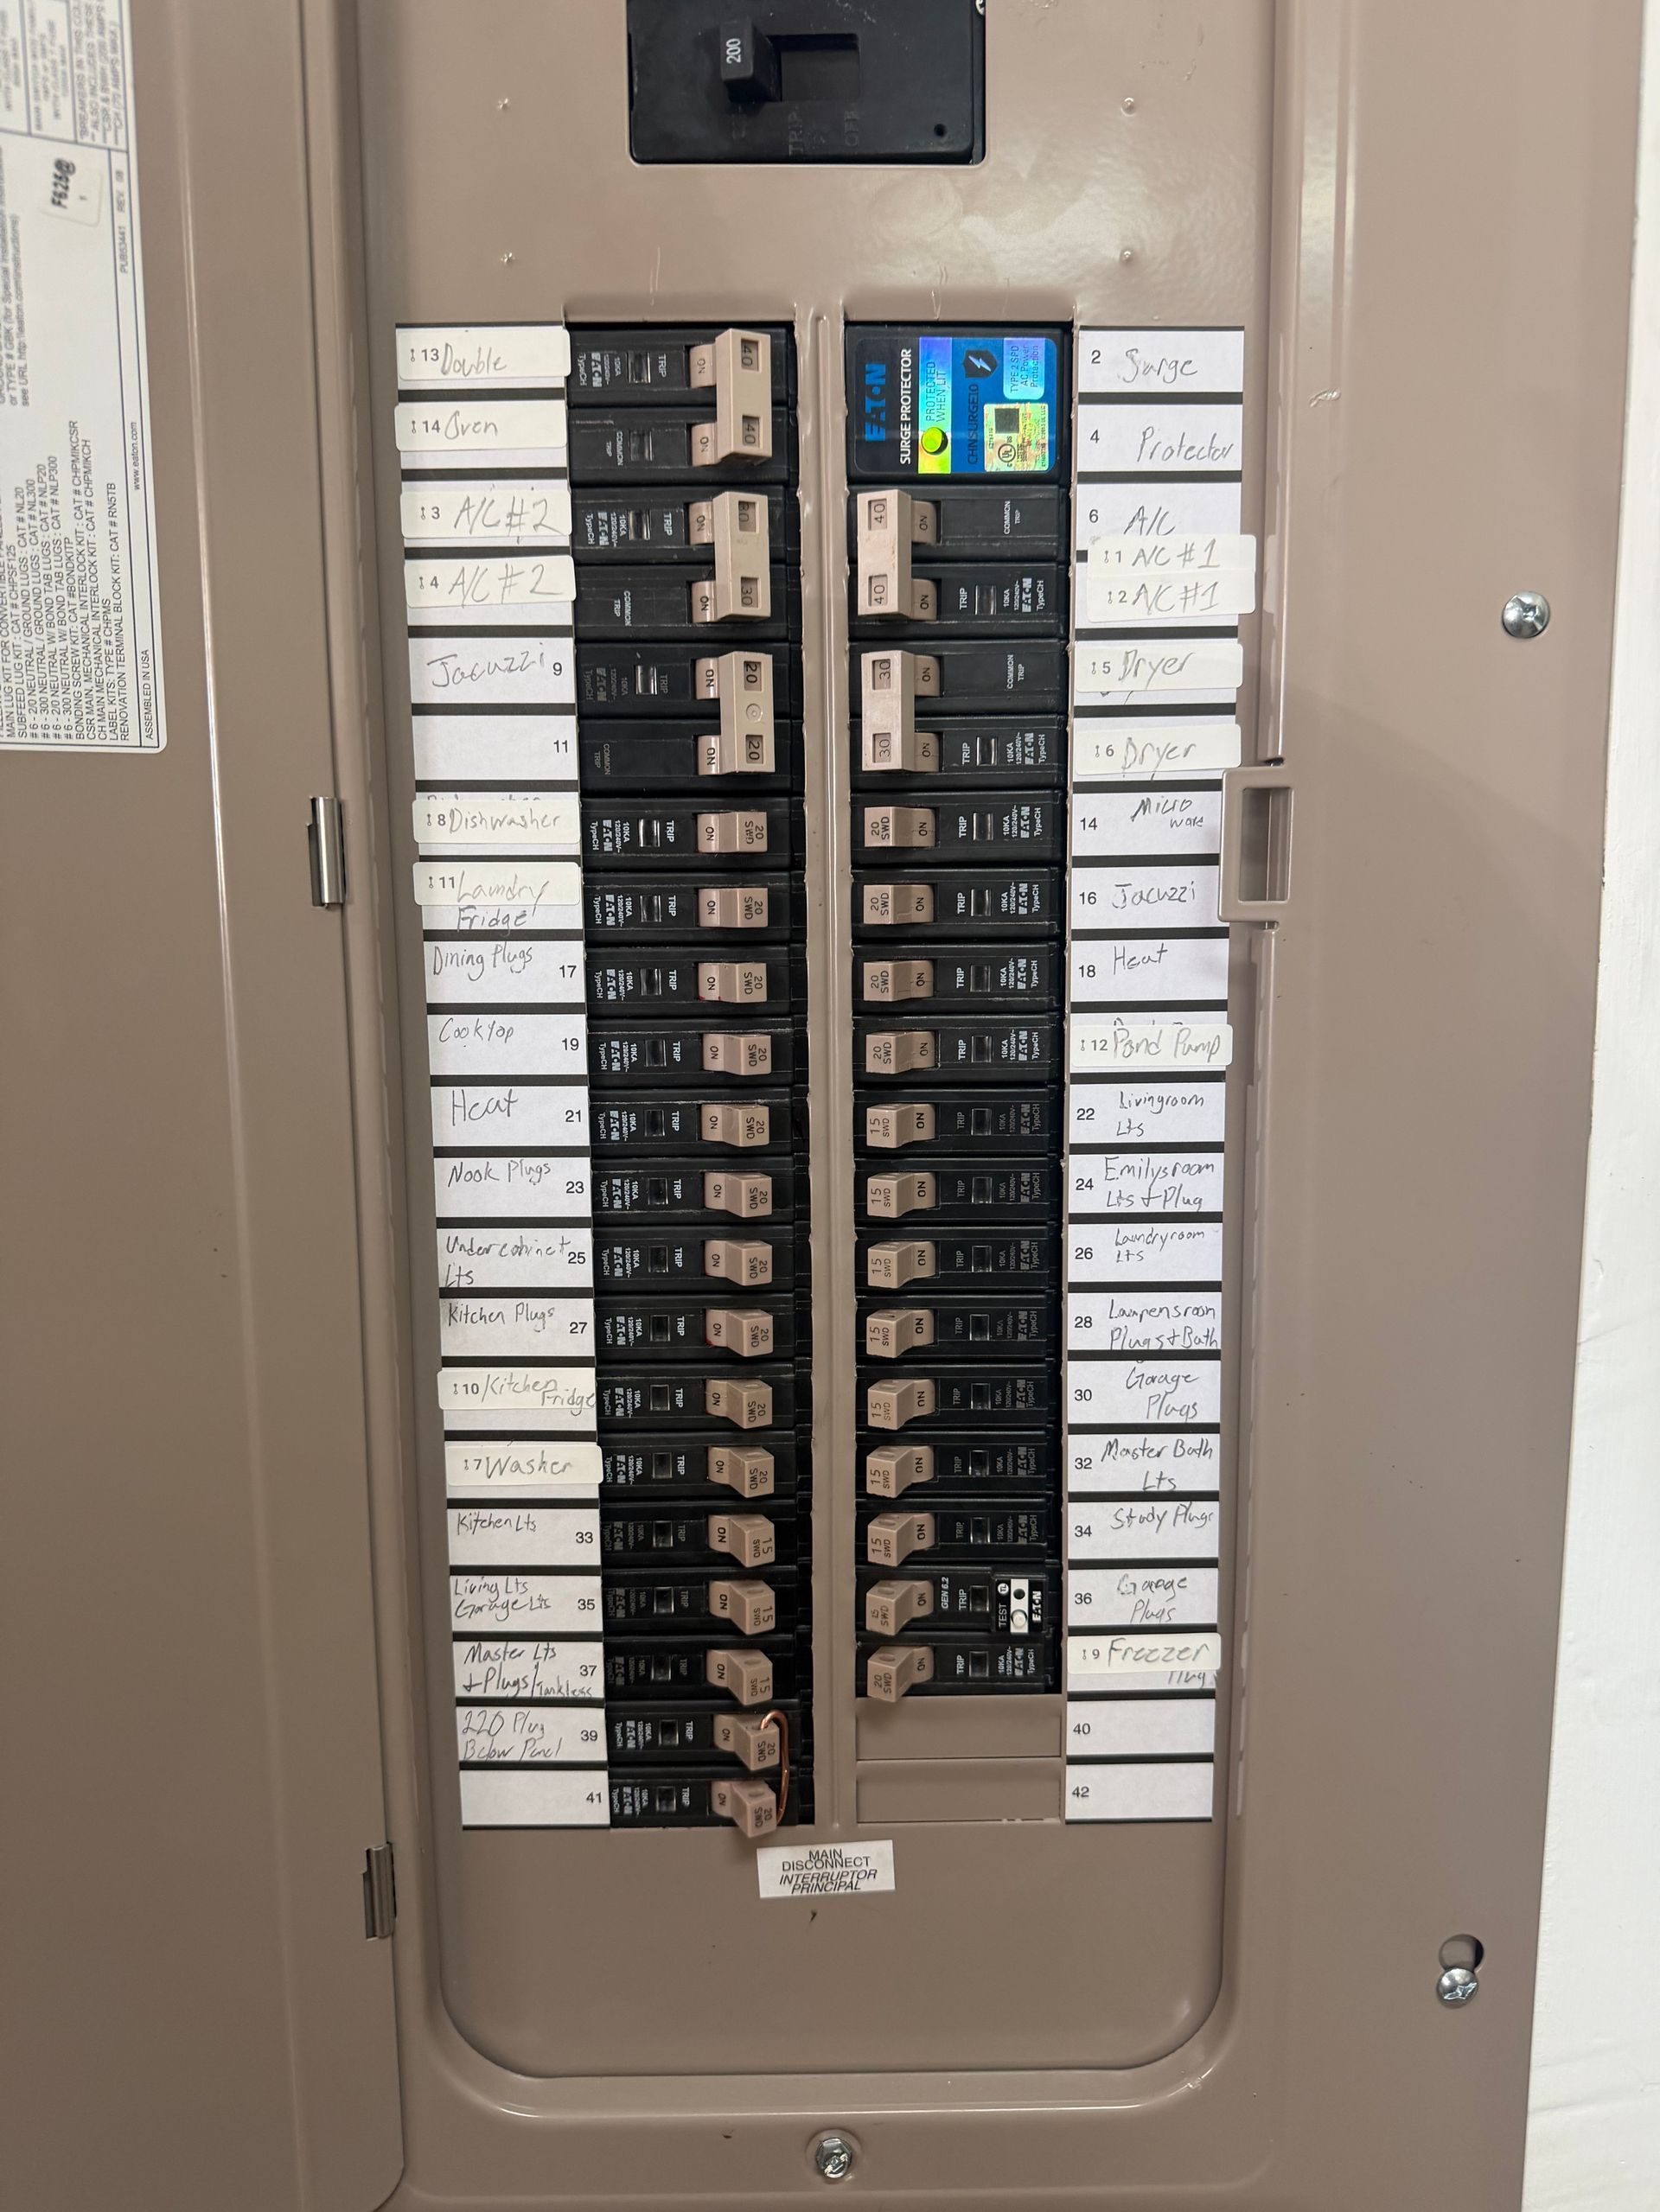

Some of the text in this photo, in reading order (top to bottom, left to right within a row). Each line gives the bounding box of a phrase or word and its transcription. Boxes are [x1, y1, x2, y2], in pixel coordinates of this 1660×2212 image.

[725, 38, 741, 64] 200
[421, 349, 439, 362] 13
[441, 342, 508, 376] Double
[741, 345, 753, 367] 40
[1012, 345, 1020, 363] SPD
[1091, 351, 1101, 364] 2
[1021, 345, 1030, 387] AC Power
[1031, 346, 1039, 388] Protection
[1122, 348, 1198, 384] Surge
[926, 361, 936, 422] PROTECTED
[1011, 373, 1019, 394] TYPE
[900, 348, 912, 465] SURGE PROTECTOR
[936, 372, 948, 422] WHEN LIT
[422, 421, 440, 433] 14
[444, 410, 498, 441] Oven
[744, 423, 757, 444] 40
[1090, 430, 1100, 443] 4
[1136, 426, 1235, 462] Protector
[130, 421, 140, 492] www.eaton.com
[432, 507, 441, 520] 3
[454, 494, 501, 535] A/C
[874, 502, 885, 524] 40
[1089, 510, 1099, 523] 6
[1116, 551, 1122, 563] 1
[1132, 538, 1221, 570] A/C #1
[430, 577, 439, 589] 4
[449, 564, 565, 608] A/C #2
[699, 595, 709, 611] ON
[1118, 590, 1127, 603] 2
[1132, 580, 1220, 612] A/C #1
[112, 577, 130, 742] RENOVATION TERMINAL BLOCK
[426, 644, 545, 688] Jacuzzi
[553, 662, 563, 676] 9
[1102, 661, 1111, 674] 5
[1119, 650, 1197, 690] Dryer
[745, 663, 757, 685] 20
[71, 653, 85, 741] BONDING SCREW
[141, 649, 154, 741] ASSEMBLED IN USA
[16, 687, 28, 738] SUBFEED
[553, 741, 568, 754] 11
[1105, 745, 1114, 757] 6
[1122, 738, 1197, 778] Dryer
[437, 814, 446, 826] 8
[449, 808, 561, 834] Dishwasher
[1080, 819, 1098, 831] 14
[667, 820, 675, 843] TRIP
[439, 877, 456, 889] 11
[456, 870, 550, 916] Laundry
[1079, 892, 1097, 905] 16
[1112, 882, 1196, 909] Jacuzzi
[457, 905, 528, 936] Fridge
[432, 944, 533, 981] Dining Plugs
[1113, 944, 1169, 976] Heat
[559, 966, 577, 978] 17
[625, 971, 634, 991] 10KA
[668, 969, 678, 991] TRIP
[1078, 966, 1095, 978] 18
[561, 1038, 579, 1051] 19
[1091, 1039, 1108, 1052] 12
[1113, 1029, 1222, 1064] Pond Pump
[450, 1088, 519, 1127] Heat
[1119, 1091, 1205, 1114] Livingroom
[565, 1111, 582, 1123] 21
[916, 1112, 925, 1130] ON
[1076, 1108, 1095, 1121] 22
[870, 1117, 880, 1137] 15
[1116, 1121, 1144, 1138] Lts
[448, 1160, 552, 1187] Nook Plugs
[565, 1182, 584, 1195] 23
[1076, 1178, 1094, 1191] 24
[1107, 1189, 1134, 1208] Lts
[1114, 1227, 1205, 1252] Laundryroom
[567, 1252, 586, 1265] 25
[1075, 1247, 1093, 1260] 26
[1115, 1249, 1144, 1263] Lts
[444, 1264, 475, 1287] Lts
[448, 1302, 555, 1333] Kitchen Plugs
[1074, 1316, 1093, 1329] 28
[569, 1322, 588, 1335] 27
[463, 1383, 479, 1395] 10
[482, 1372, 559, 1395] Kitchen
[1126, 1367, 1200, 1393] Garage
[540, 1387, 597, 1416] Fridge
[1074, 1389, 1093, 1402] 30
[1146, 1392, 1199, 1420] Plugs
[1101, 1437, 1213, 1461] Master Bath
[474, 1459, 482, 1471] 7
[485, 1450, 572, 1476] Washer
[1074, 1457, 1093, 1470] 32
[1142, 1470, 1177, 1492] Lts
[456, 1514, 537, 1536] Kitchen Lts
[1110, 1507, 1168, 1534] Study
[575, 1531, 594, 1544] 33
[1074, 1525, 1093, 1538] 34
[454, 1576, 529, 1600] Living Lts
[1074, 1591, 1093, 1605] 36
[455, 1592, 552, 1622] Garage Lts
[577, 1597, 596, 1610] 35
[1129, 1598, 1177, 1623] Plugs
[998, 1602, 1008, 1628] TEST
[464, 1641, 557, 1665] Master Lts
[1092, 1648, 1101, 1661] 9
[1107, 1636, 1210, 1667] Freezer
[579, 1664, 597, 1677] 37
[462, 1710, 546, 1740] 220 Plug
[580, 1729, 598, 1742] 39
[1073, 1723, 1091, 1736] 40
[463, 1737, 563, 1762] Below Panel
[586, 1792, 603, 1804] 41
[1071, 1786, 1090, 1799] 42
[782, 1856, 872, 1871] DISCONNECT
[808, 1848, 844, 1861] MAIN
[779, 1869, 878, 1886] INTERRUPTOR
[791, 1880, 863, 1895] PRINCIPAL
